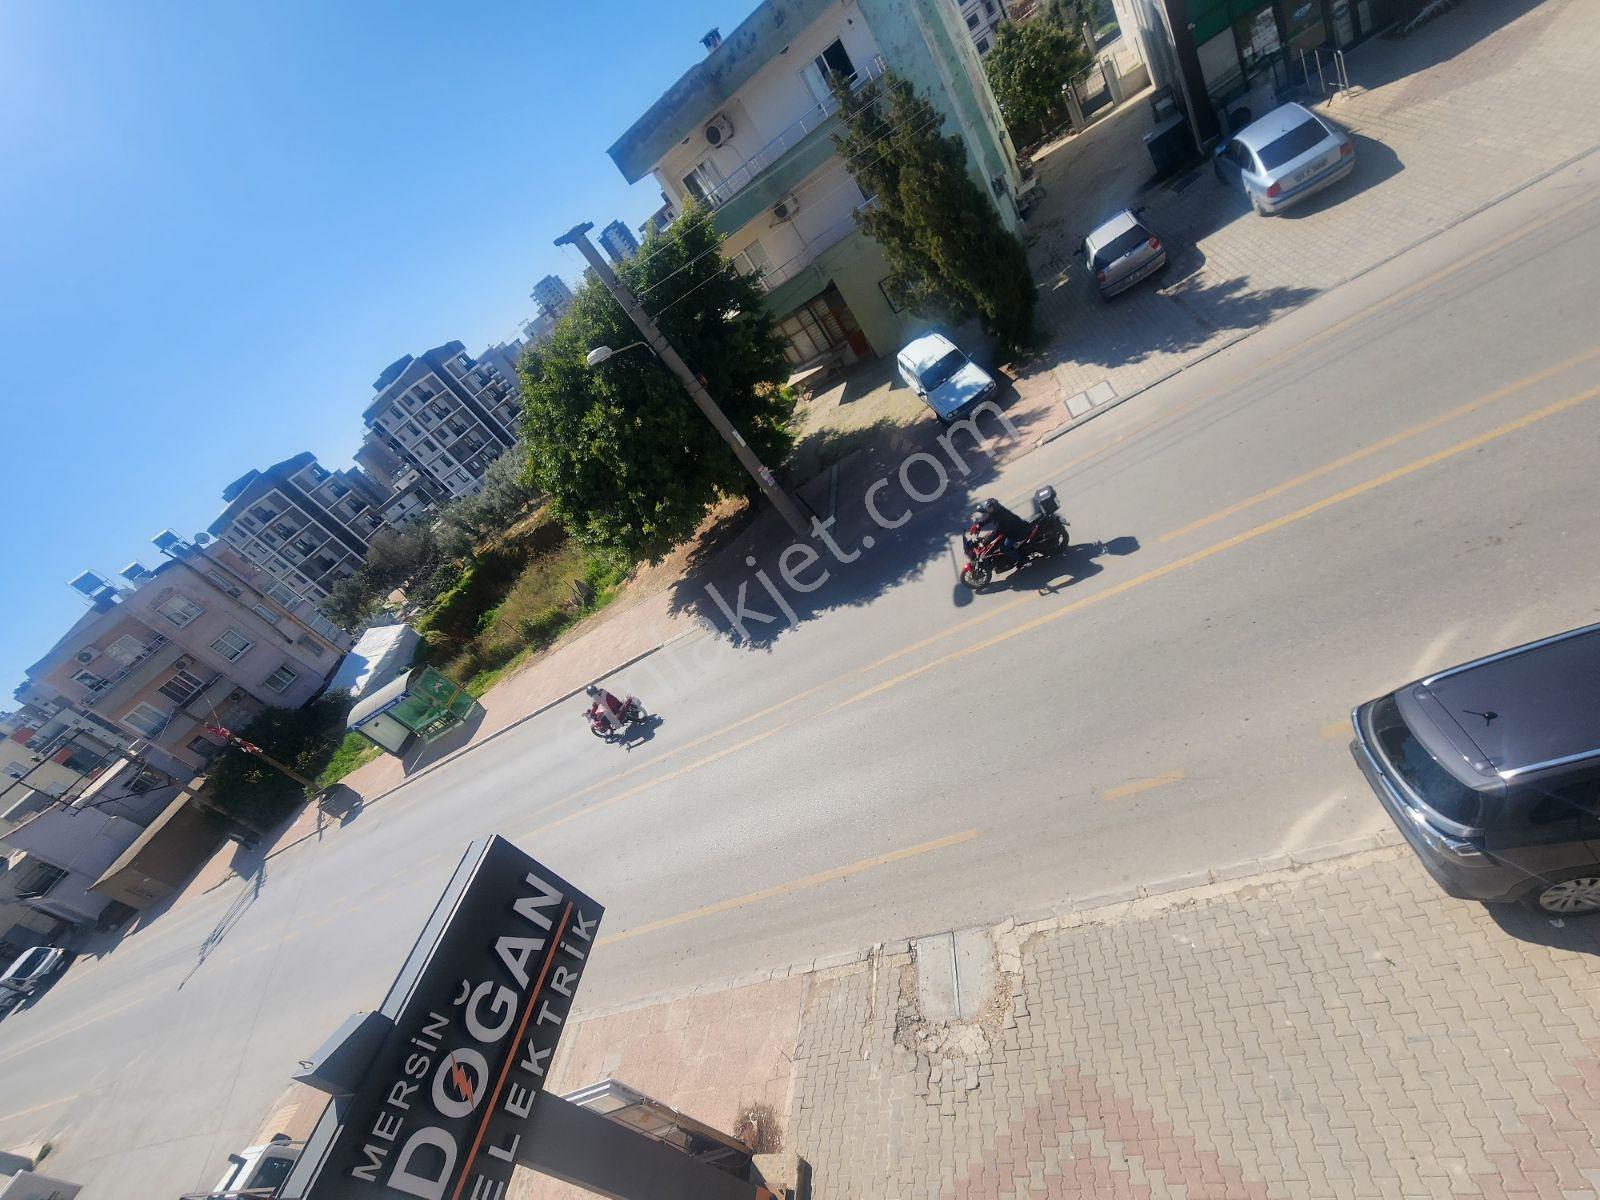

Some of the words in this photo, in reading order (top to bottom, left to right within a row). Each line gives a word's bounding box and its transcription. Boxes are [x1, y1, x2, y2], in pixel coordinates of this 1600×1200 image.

[352, 1011, 450, 1182] MERSİN
[386, 872, 564, 1200] DOĞAN
[470, 909, 598, 1200] ELEKTRİK
